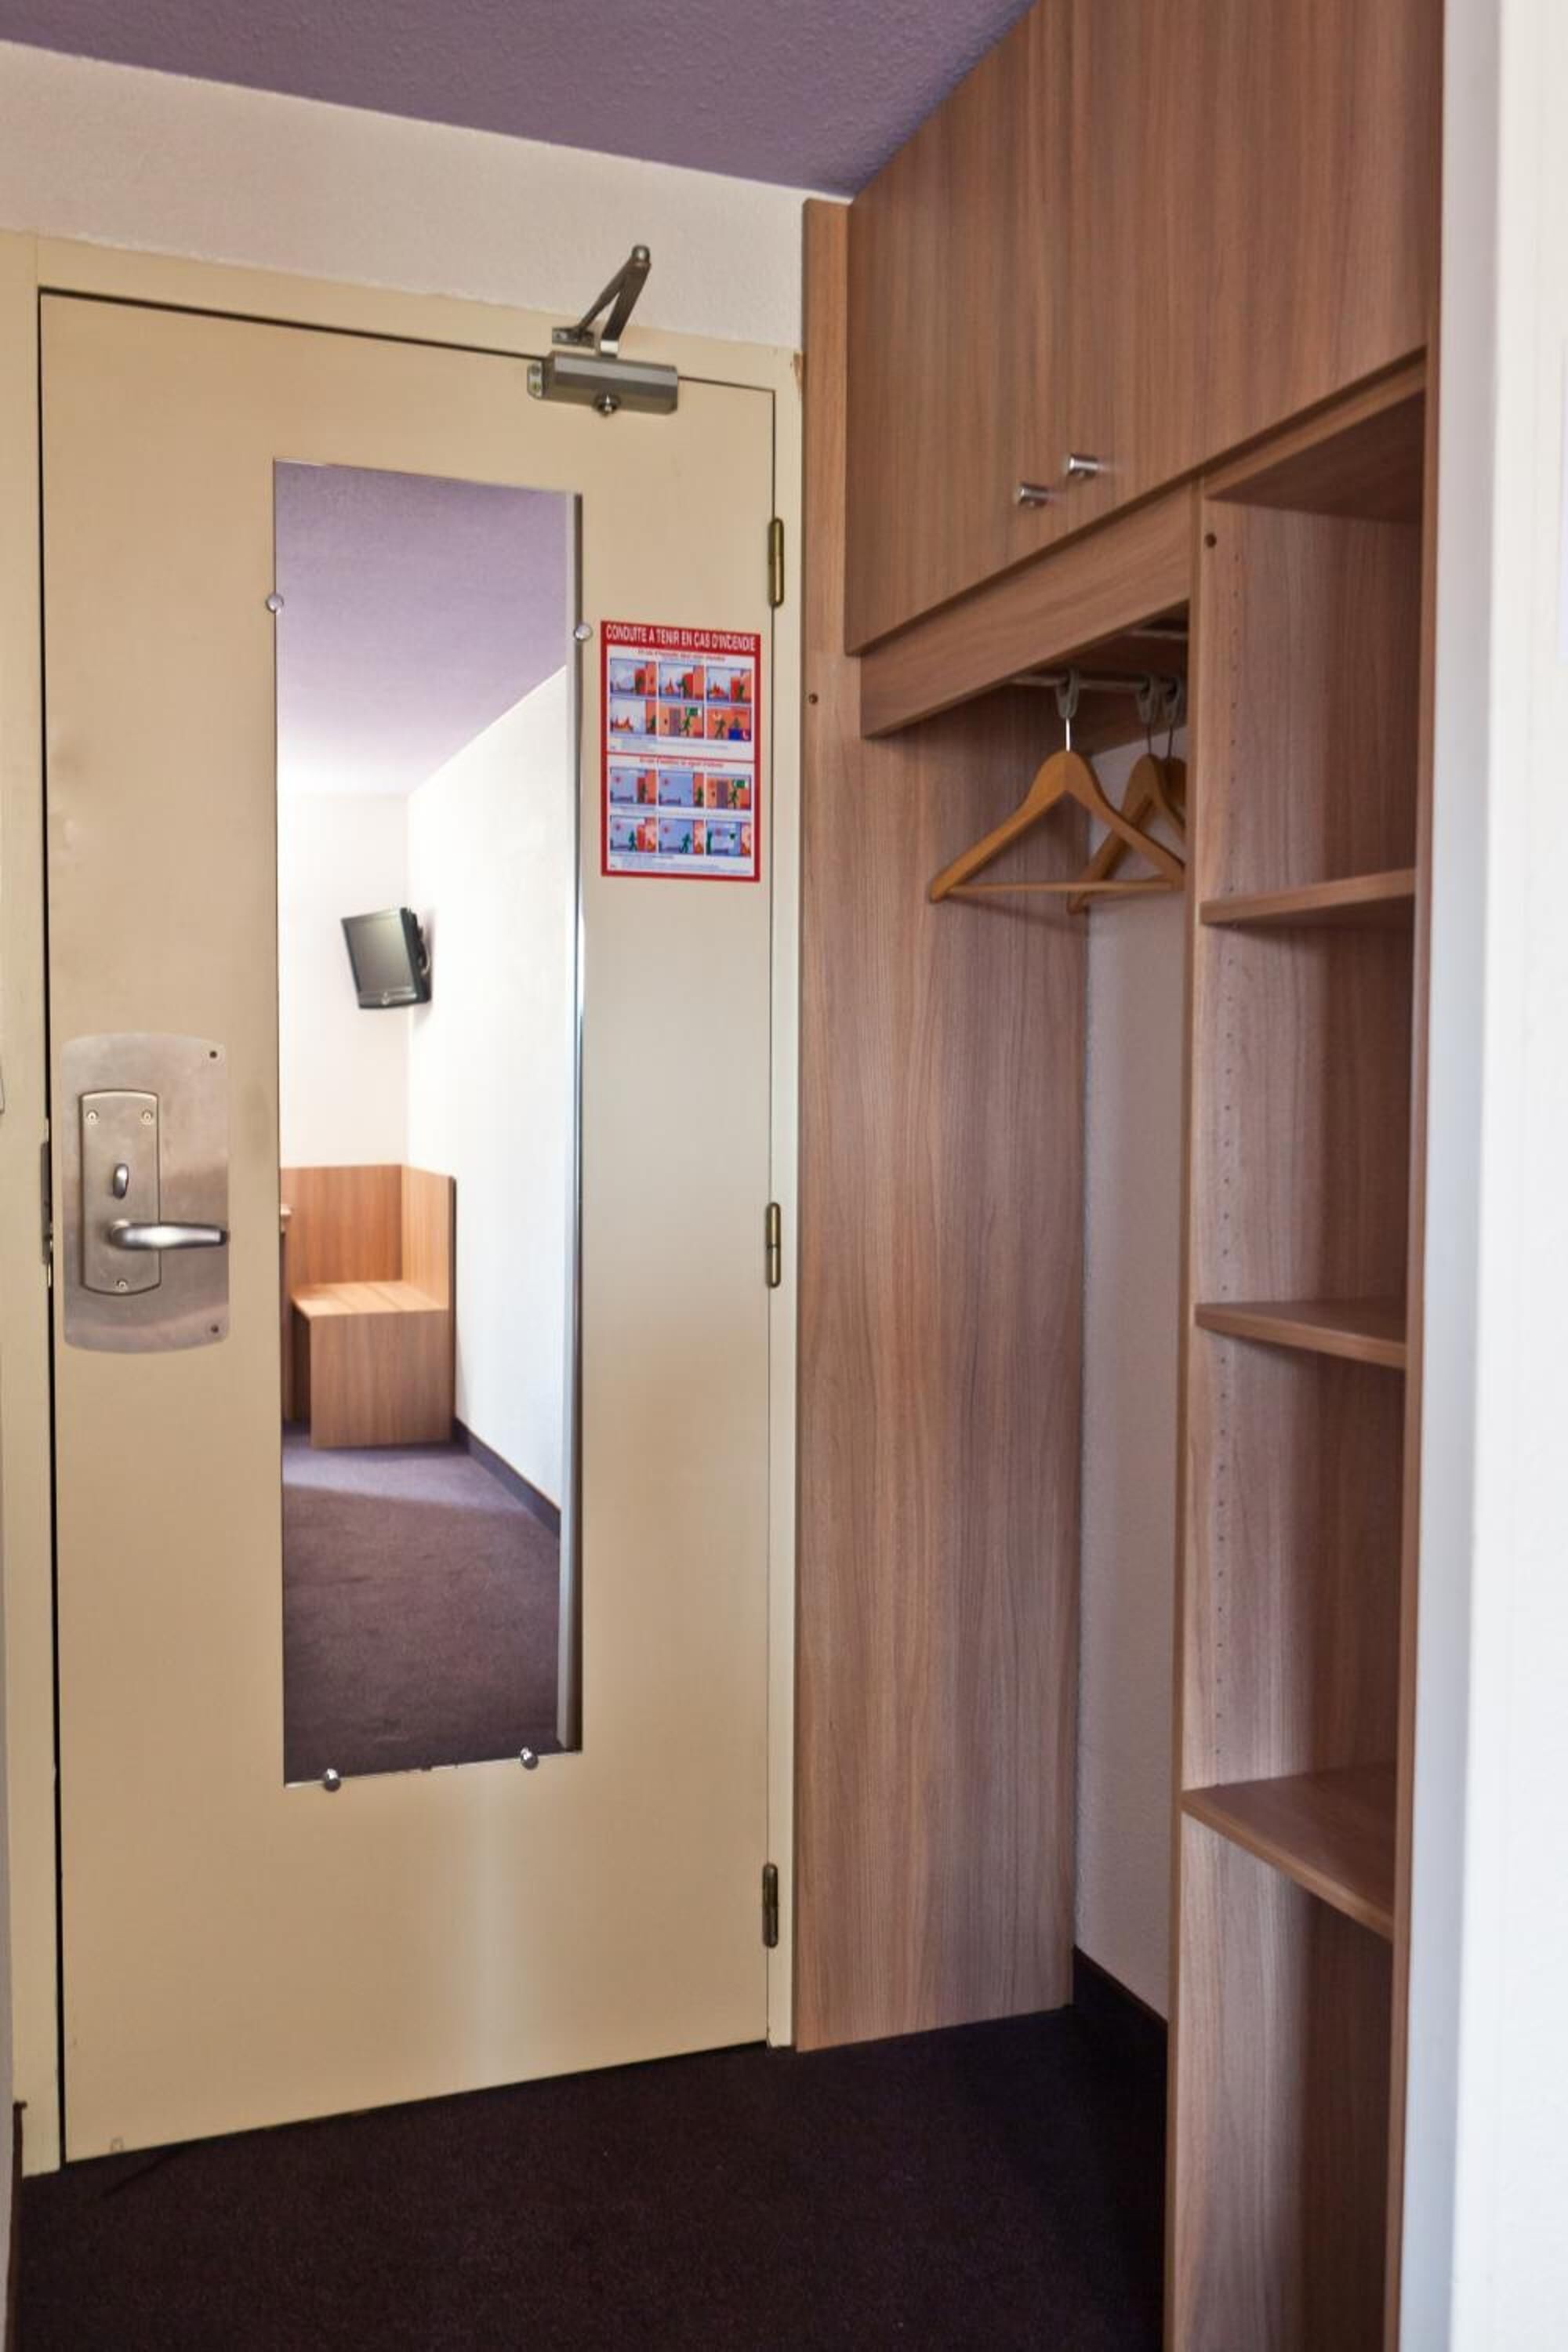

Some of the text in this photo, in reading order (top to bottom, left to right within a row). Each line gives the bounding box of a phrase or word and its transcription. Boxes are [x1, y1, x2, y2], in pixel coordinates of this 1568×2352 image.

[606, 625, 756, 652] CONDUITE A TENIR EN CAS D'INCENDIE
